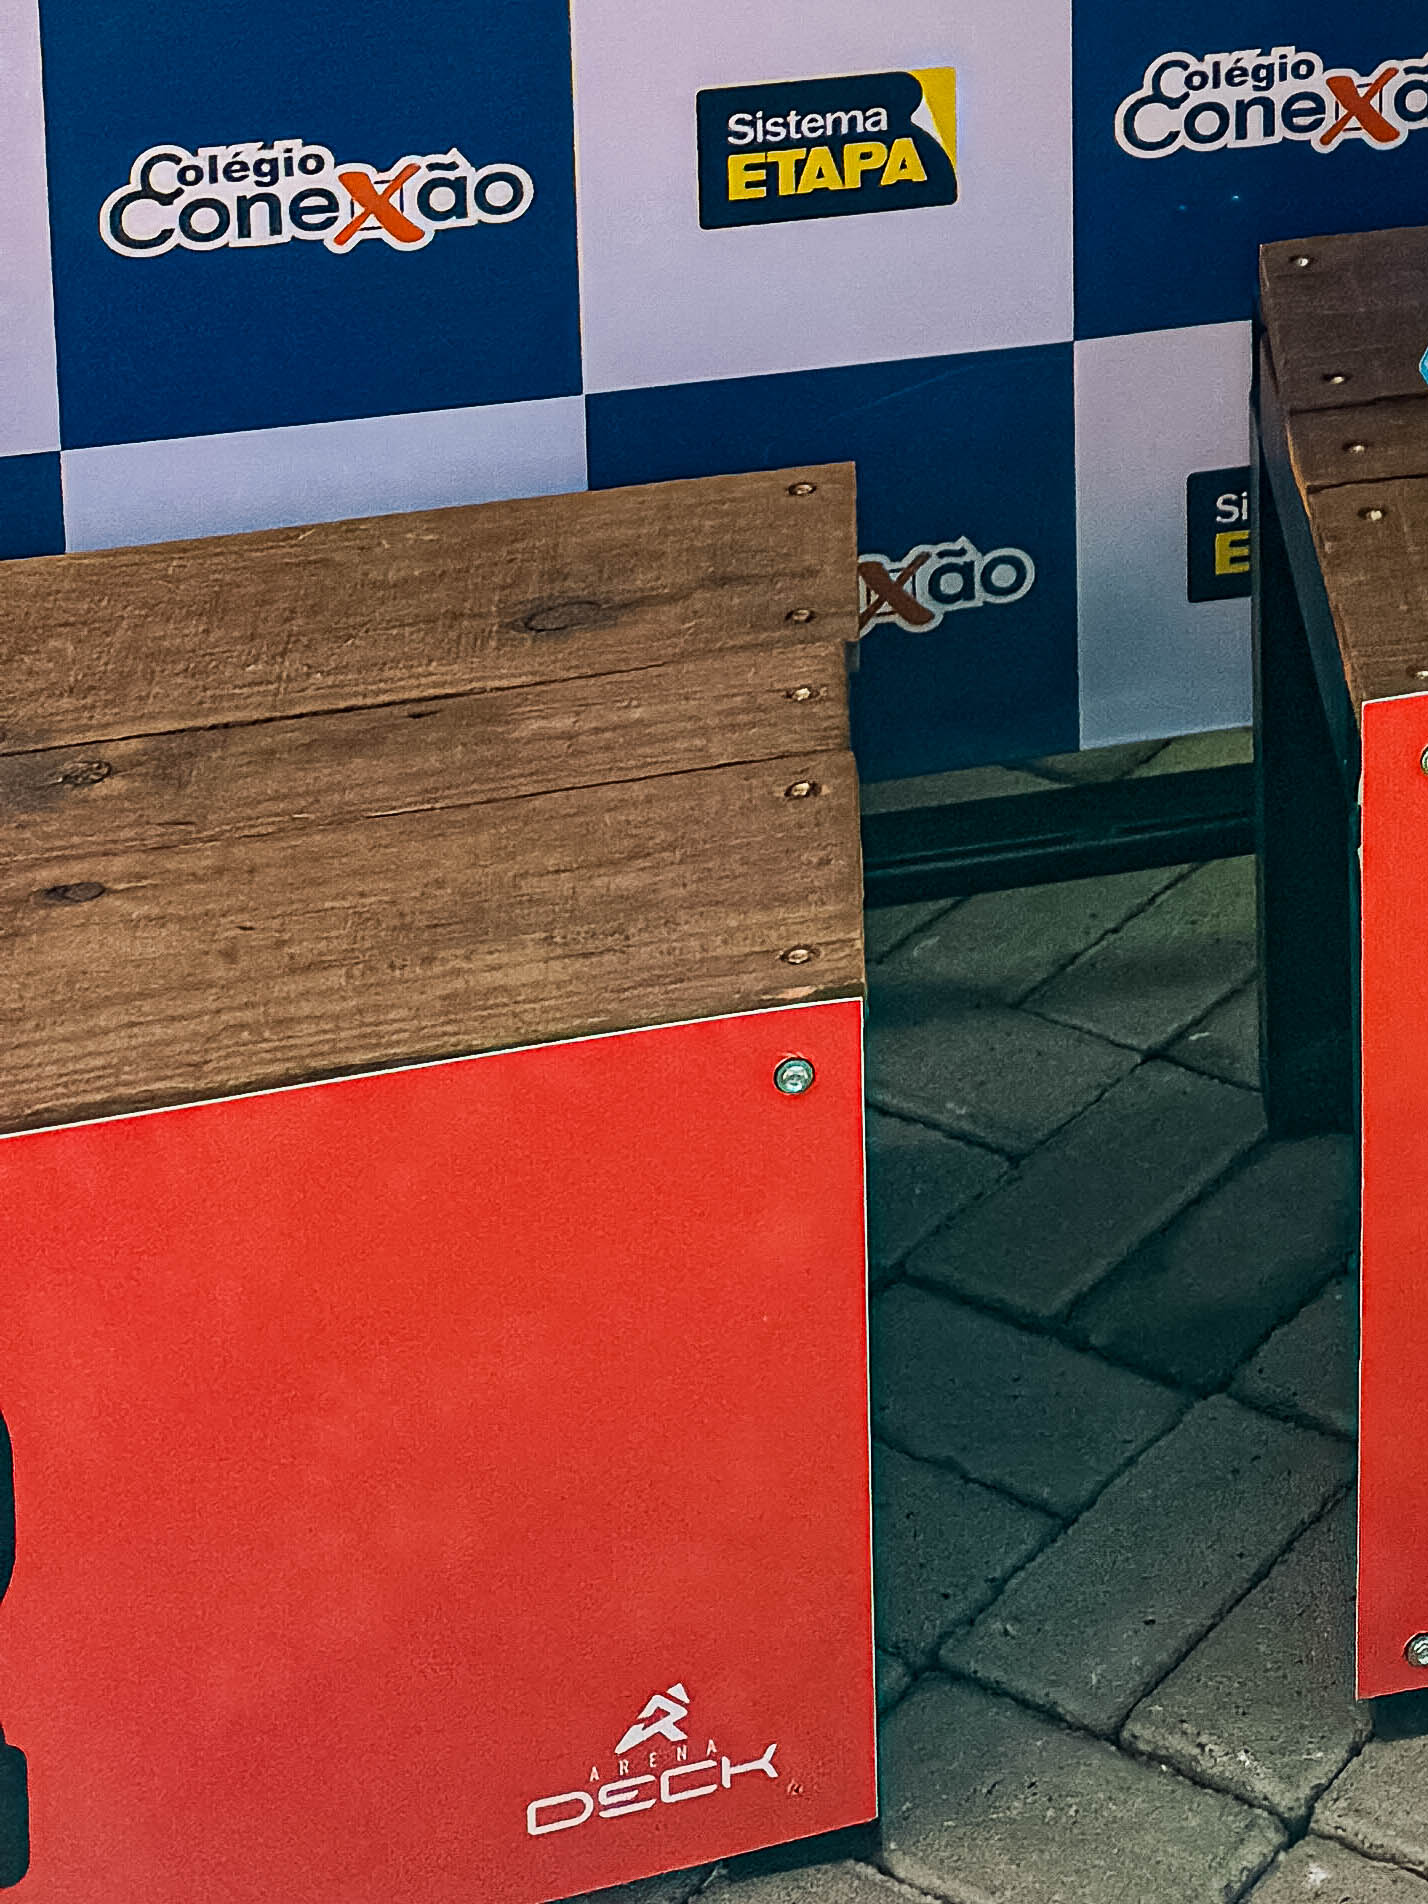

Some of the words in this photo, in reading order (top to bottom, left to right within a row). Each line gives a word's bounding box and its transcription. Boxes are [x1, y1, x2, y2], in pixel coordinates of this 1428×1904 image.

[1157, 53, 1315, 100] Colégio
[728, 103, 887, 145] Sistema
[142, 147, 322, 193] Colégio
[728, 136, 926, 200] ETAPA
[589, 1739, 719, 1781] ARENA
[527, 1744, 778, 1836] DECK
